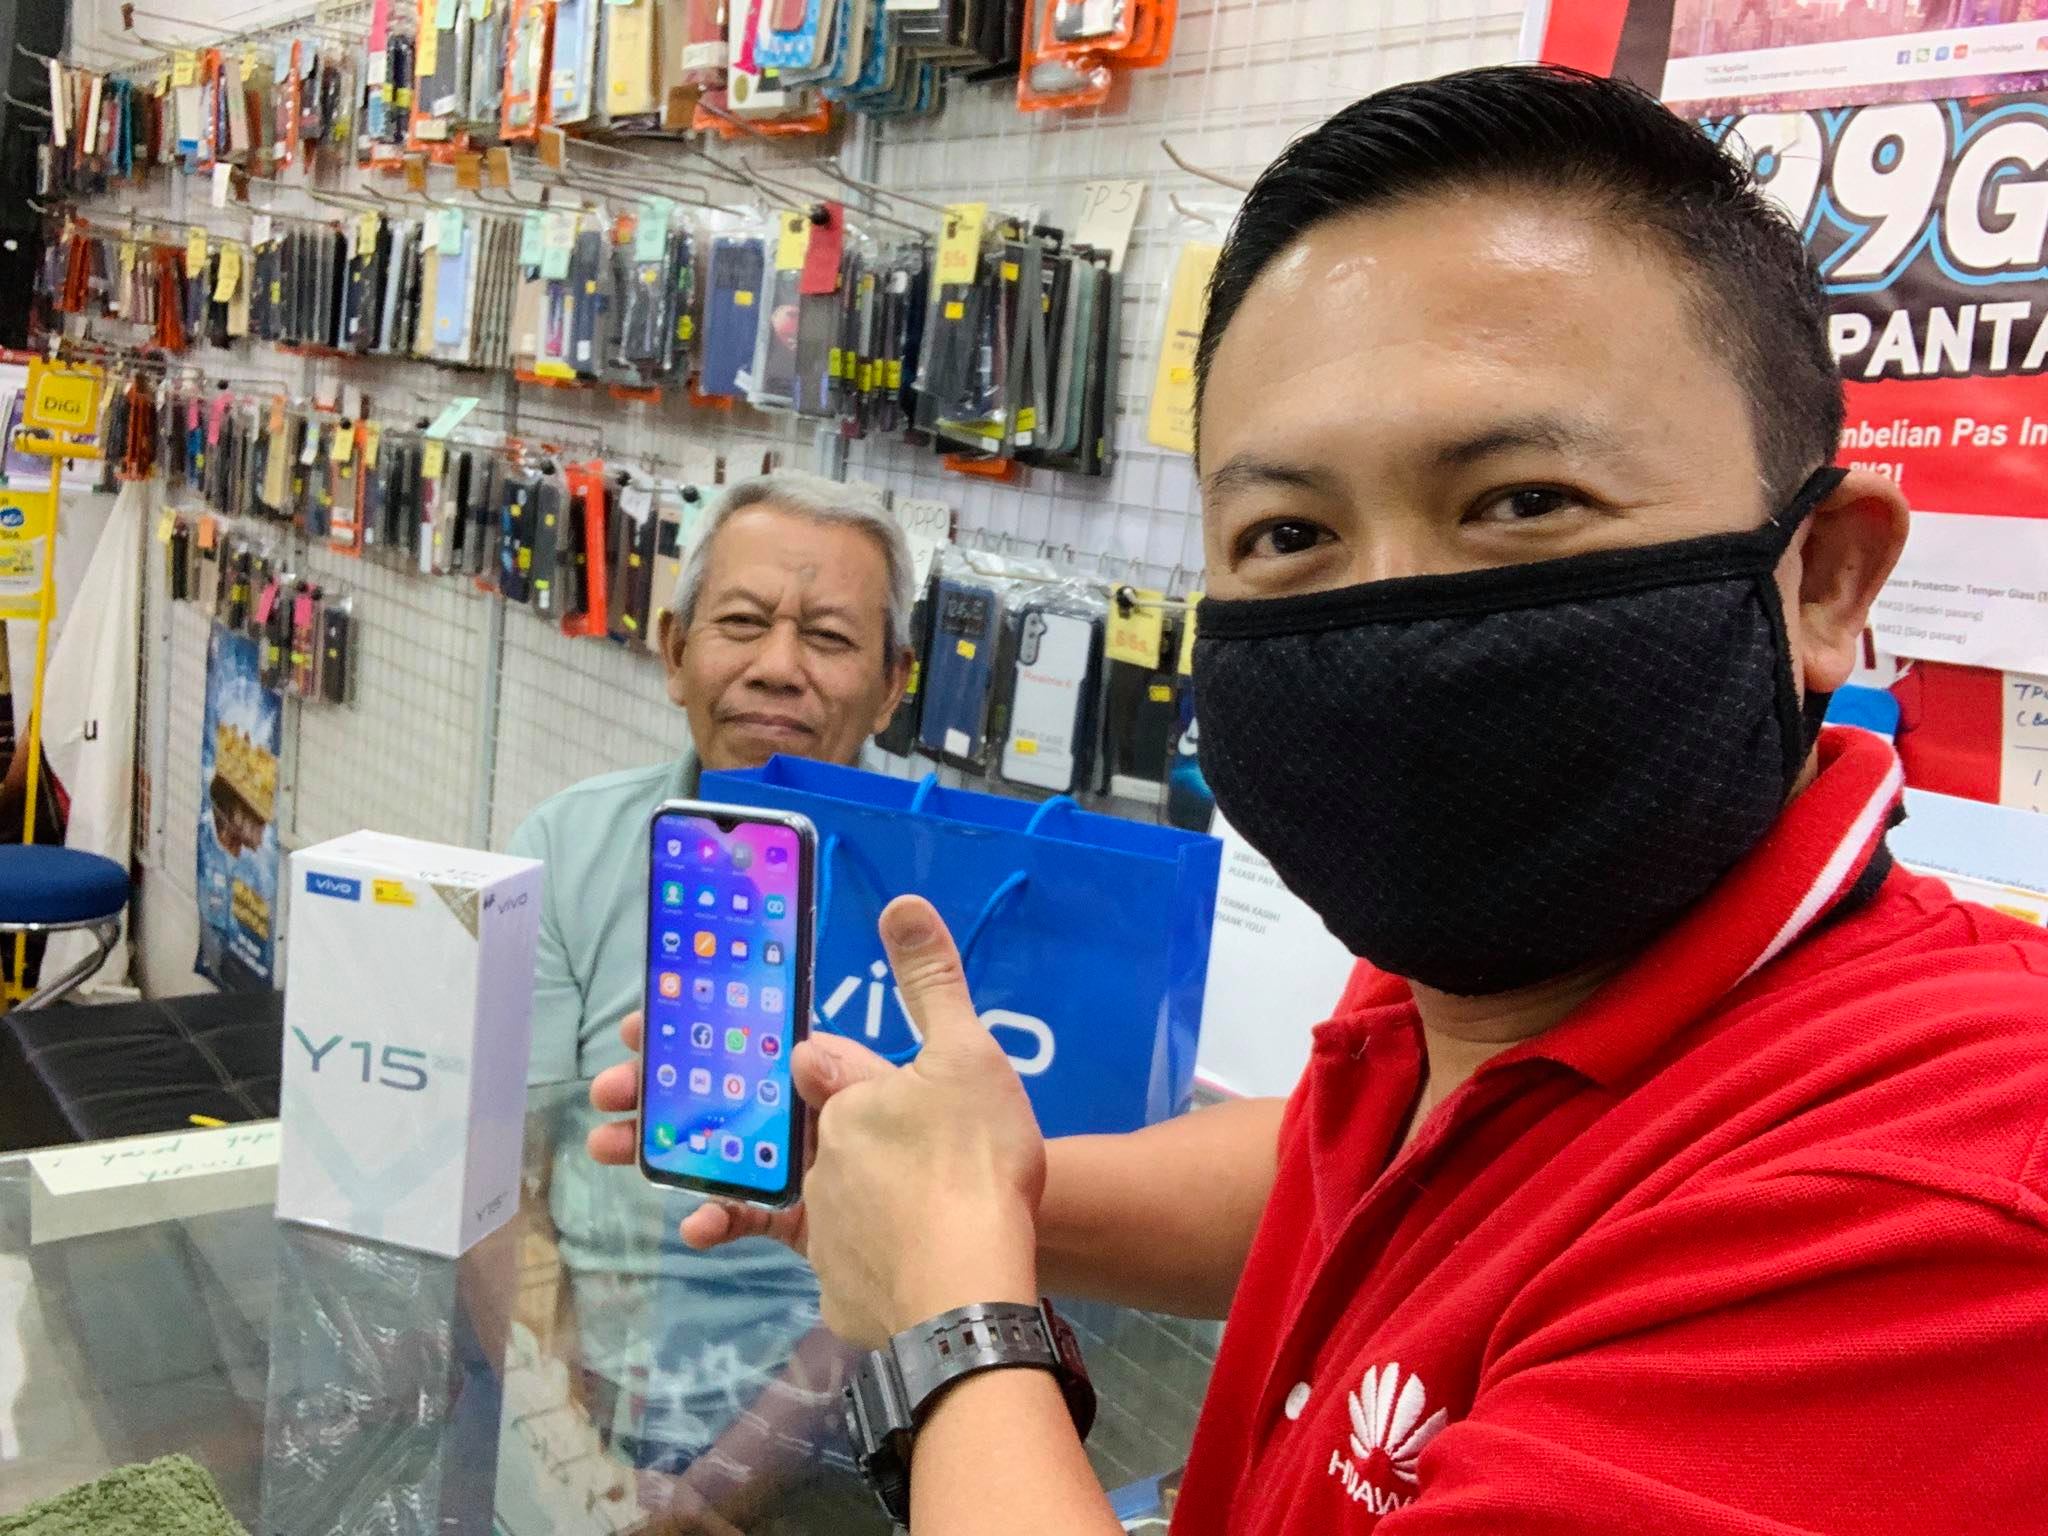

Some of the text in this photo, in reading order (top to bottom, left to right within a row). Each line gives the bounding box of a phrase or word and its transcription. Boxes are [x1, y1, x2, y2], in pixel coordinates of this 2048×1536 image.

[1951, 417, 2009, 448] Pas
[1966, 584, 2005, 598] Temper
[2008, 588, 2036, 600] Glass
[315, 878, 352, 894] vivo
[292, 1025, 429, 1092] Y15
